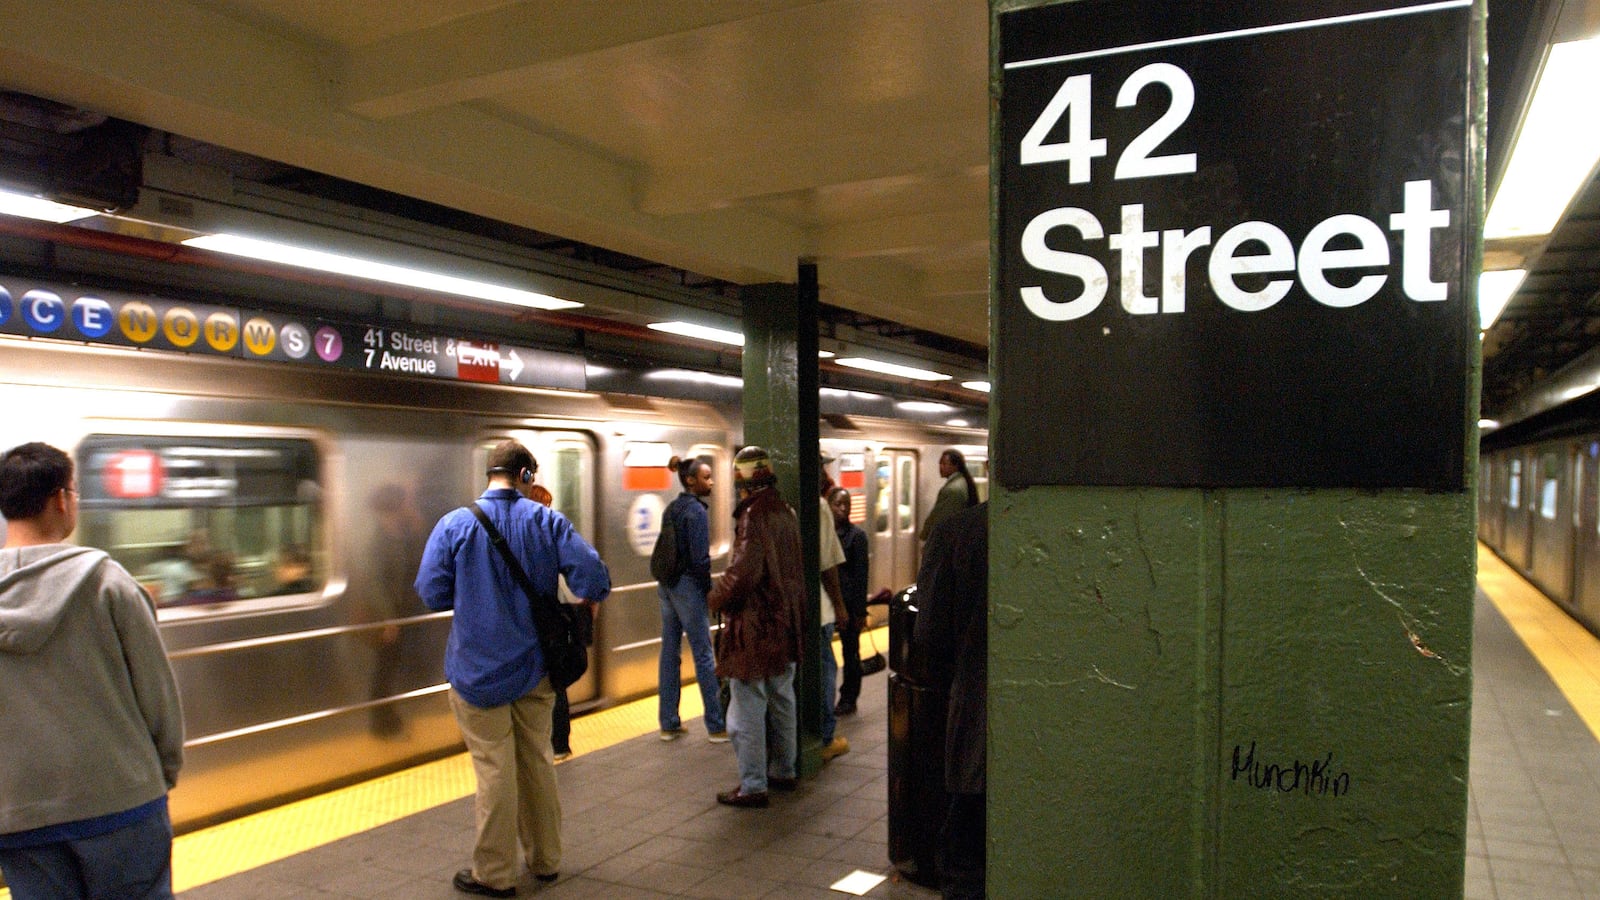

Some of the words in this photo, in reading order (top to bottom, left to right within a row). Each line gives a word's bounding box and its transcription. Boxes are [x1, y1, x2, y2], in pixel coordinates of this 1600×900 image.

[1020, 62, 1197, 185] 42
[1020, 180, 1450, 322] Street
[32, 298, 55, 323] C
[84, 303, 102, 329] E
[130, 310, 148, 333] N
[173, 315, 192, 337] Q
[214, 320, 230, 341] R
[249, 324, 272, 347] W
[288, 330, 304, 351] S
[322, 333, 335, 354] 7
[364, 328, 384, 348] 41
[391, 331, 438, 354] Street
[445, 341, 457, 358] &
[364, 349, 375, 368] 7
[380, 351, 436, 374] Avenue
[457, 341, 496, 367] Exit
